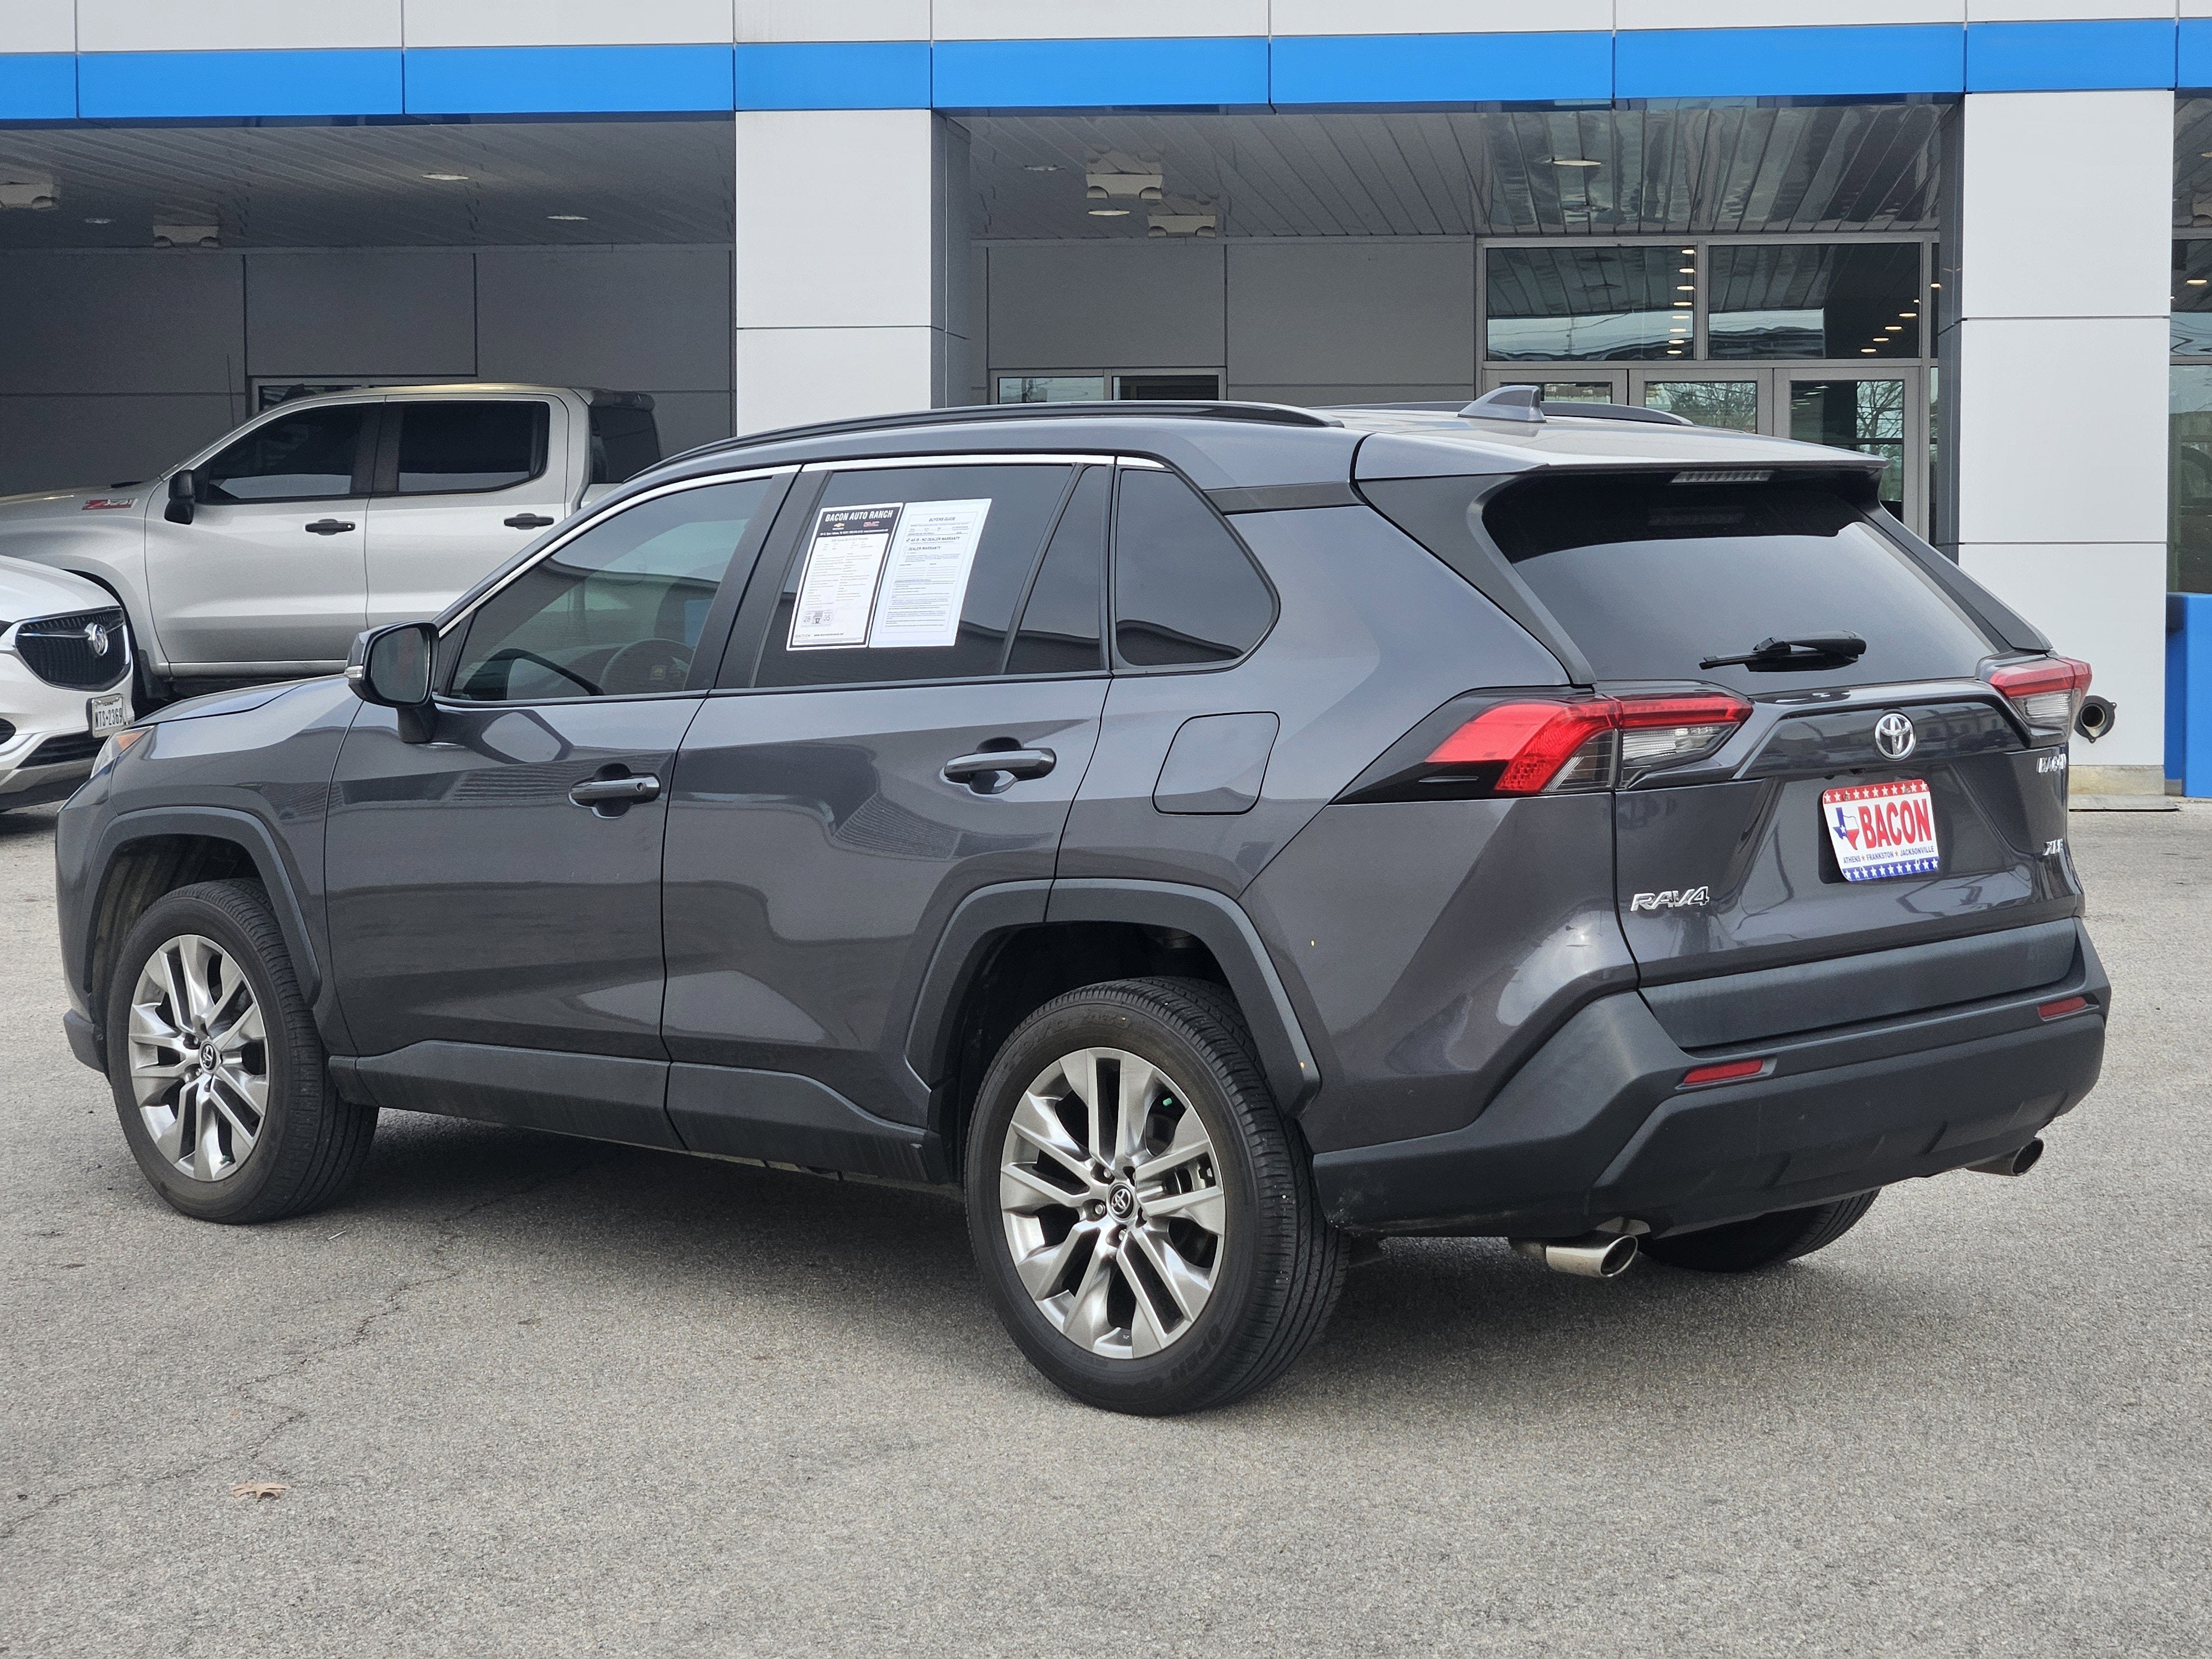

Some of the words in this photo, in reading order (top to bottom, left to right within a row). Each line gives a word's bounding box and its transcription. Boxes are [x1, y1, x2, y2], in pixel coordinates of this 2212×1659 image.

[825, 513, 849, 522] BACON
[848, 511, 868, 520] AUTO
[868, 509, 894, 519] RANCH
[1858, 798, 1932, 849] BACON
[1843, 855, 1861, 864] ATHENS
[1866, 851, 1895, 861] FRANKSTON
[1900, 846, 1935, 857] JACKSONVILLE
[1630, 886, 1710, 911] RAV4
